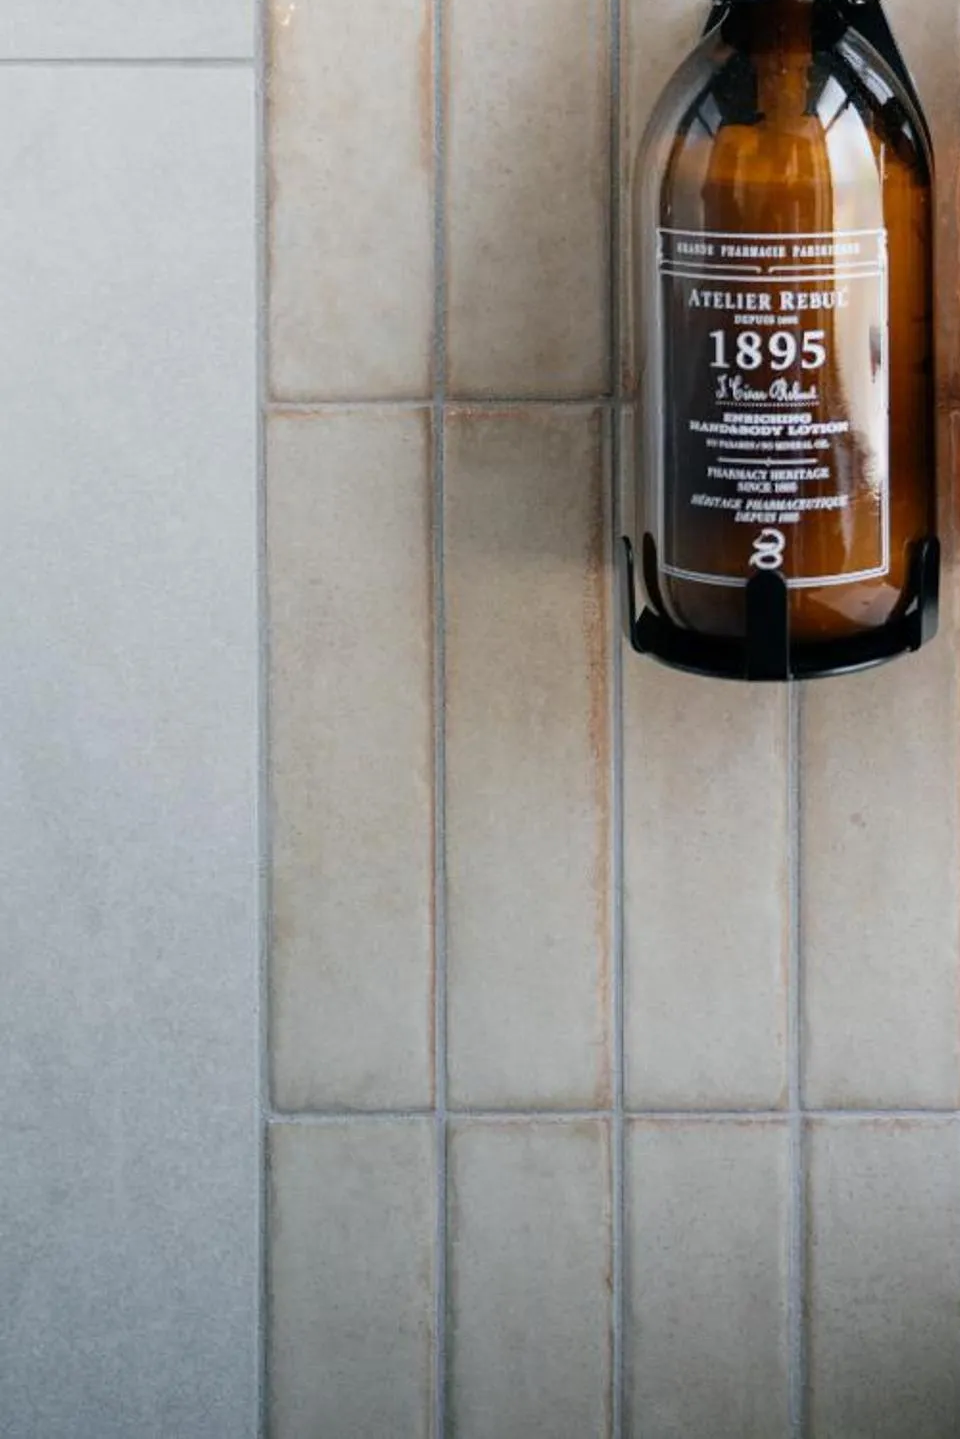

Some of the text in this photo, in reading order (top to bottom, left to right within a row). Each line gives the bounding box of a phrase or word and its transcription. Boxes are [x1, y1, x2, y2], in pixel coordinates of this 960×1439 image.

[689, 289, 772, 310] ATELIER
[709, 329, 826, 370] 1895
[788, 421, 849, 436] LOTION
[707, 467, 767, 480] PHARMACY
